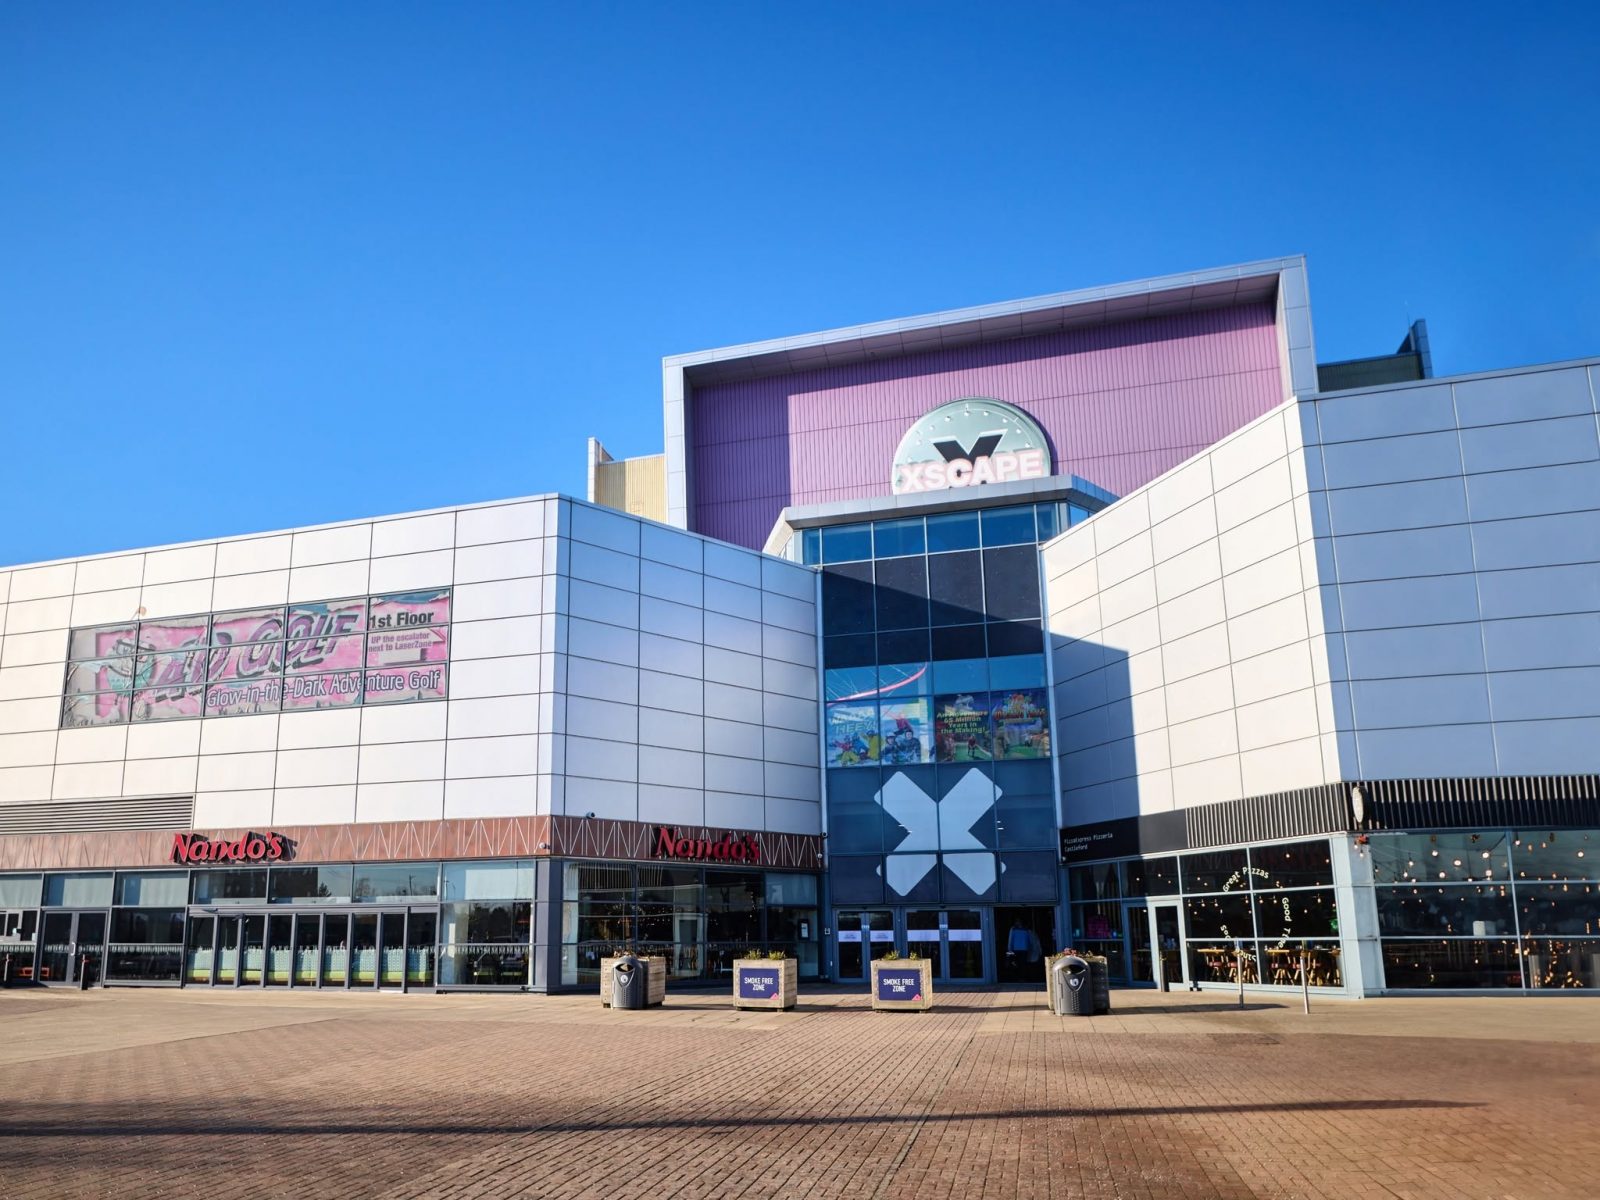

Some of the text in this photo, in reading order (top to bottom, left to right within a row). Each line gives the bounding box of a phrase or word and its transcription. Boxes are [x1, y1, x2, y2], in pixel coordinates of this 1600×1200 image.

[897, 449, 1044, 492] XSCAPE
[370, 612, 434, 628] 1st Floor
[369, 641, 432, 652] next to LaserZone
[371, 636, 382, 644] UP
[397, 632, 430, 641] escalator
[329, 672, 404, 695] Adventure
[409, 670, 441, 689] Golf
[169, 831, 284, 861] Nando's
[655, 826, 761, 862] Nando's
[1222, 871, 1241, 892] Great
[1282, 897, 1292, 922] Good
